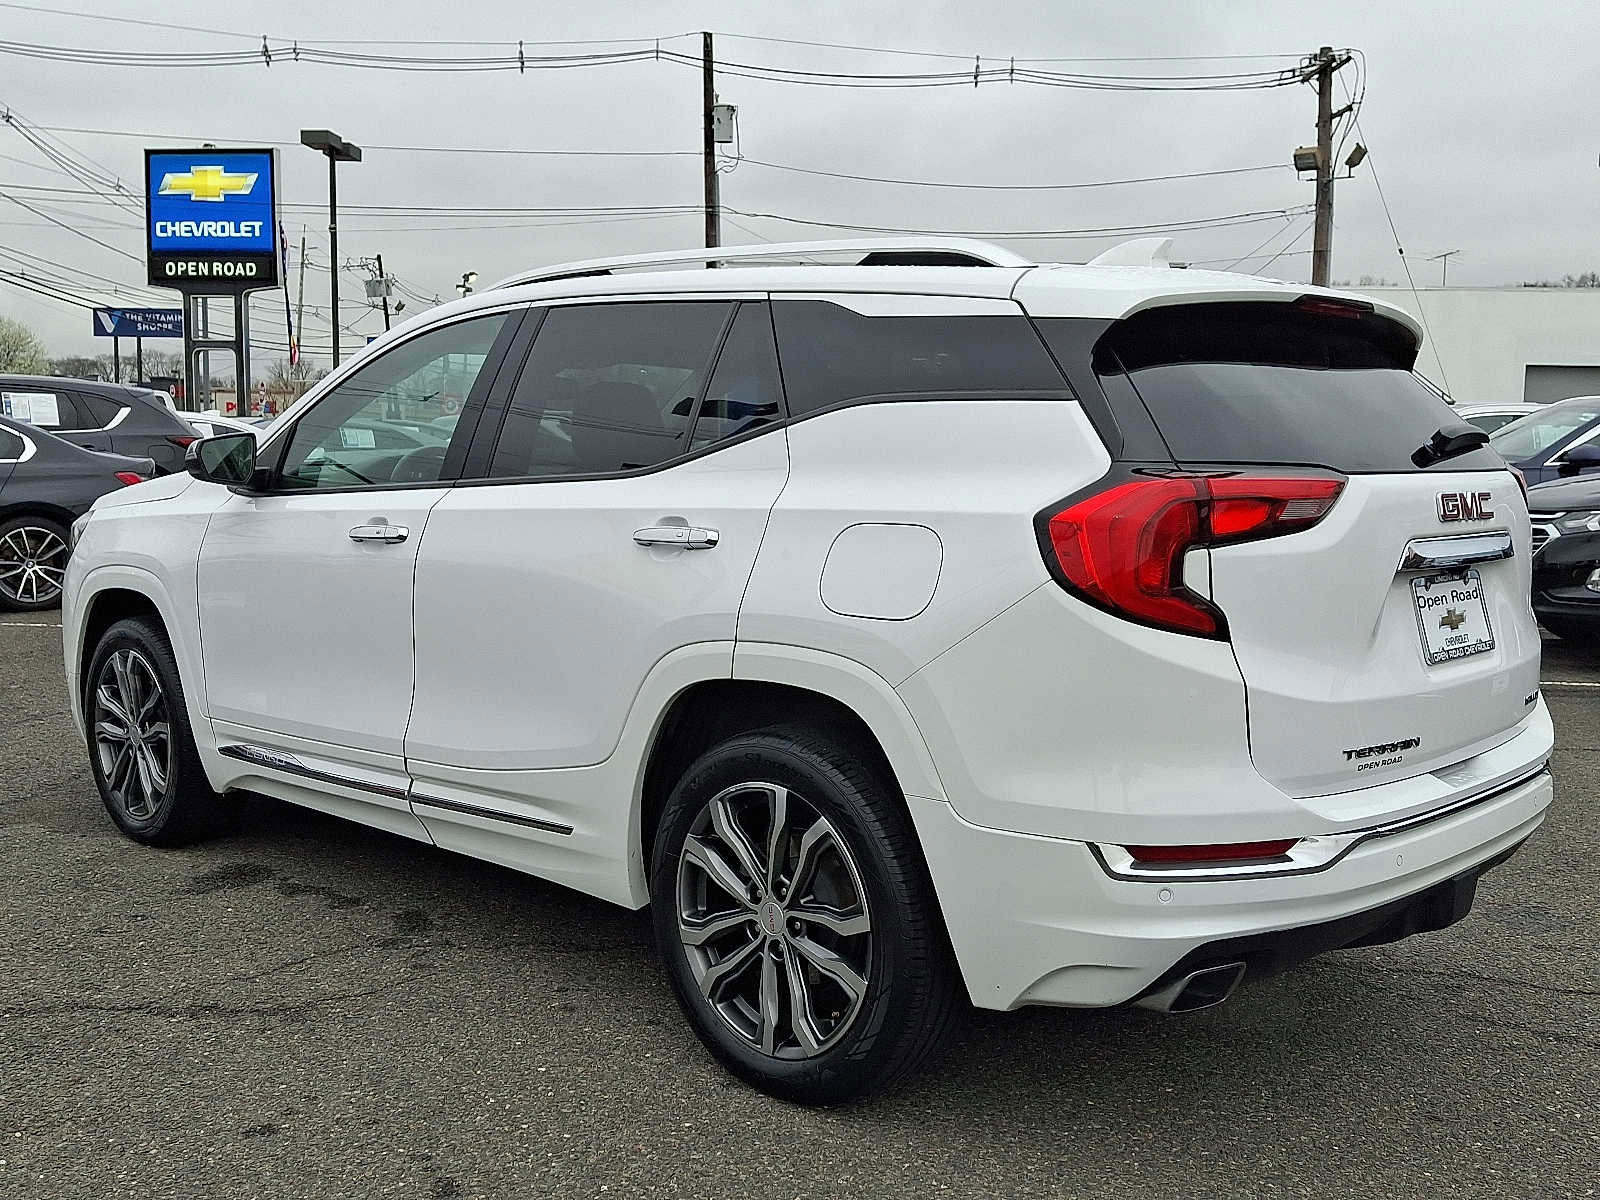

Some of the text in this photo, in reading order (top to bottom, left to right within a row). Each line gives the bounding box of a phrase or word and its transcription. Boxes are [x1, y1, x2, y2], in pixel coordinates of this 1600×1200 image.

[155, 221, 263, 237] CHEVROLET
[165, 261, 257, 276] OPEN ROAD
[125, 313, 143, 321] THE
[1436, 491, 1495, 522] GMC
[1417, 587, 1479, 611] Open Road
[1433, 640, 1494, 662] OPEN ROAD CHEVROLET
[1342, 736, 1421, 761] TERRAIN
[1357, 755, 1403, 772] OPEN ROAD
